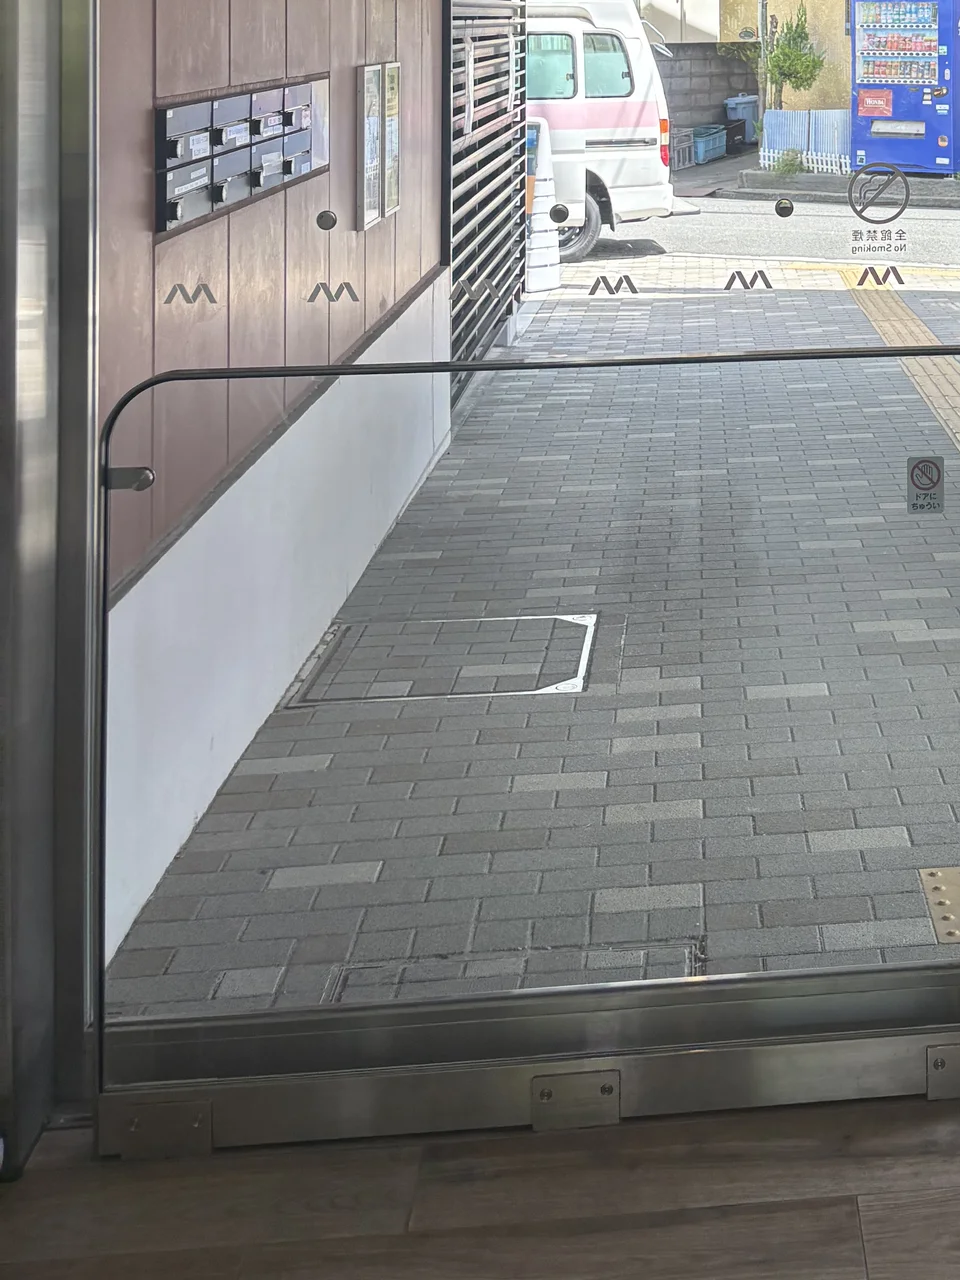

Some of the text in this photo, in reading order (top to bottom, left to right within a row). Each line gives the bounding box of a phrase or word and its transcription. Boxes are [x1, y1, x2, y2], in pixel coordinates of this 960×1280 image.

[915, 492, 937, 501] ドアに
[911, 502, 941, 510] ちゅうい
